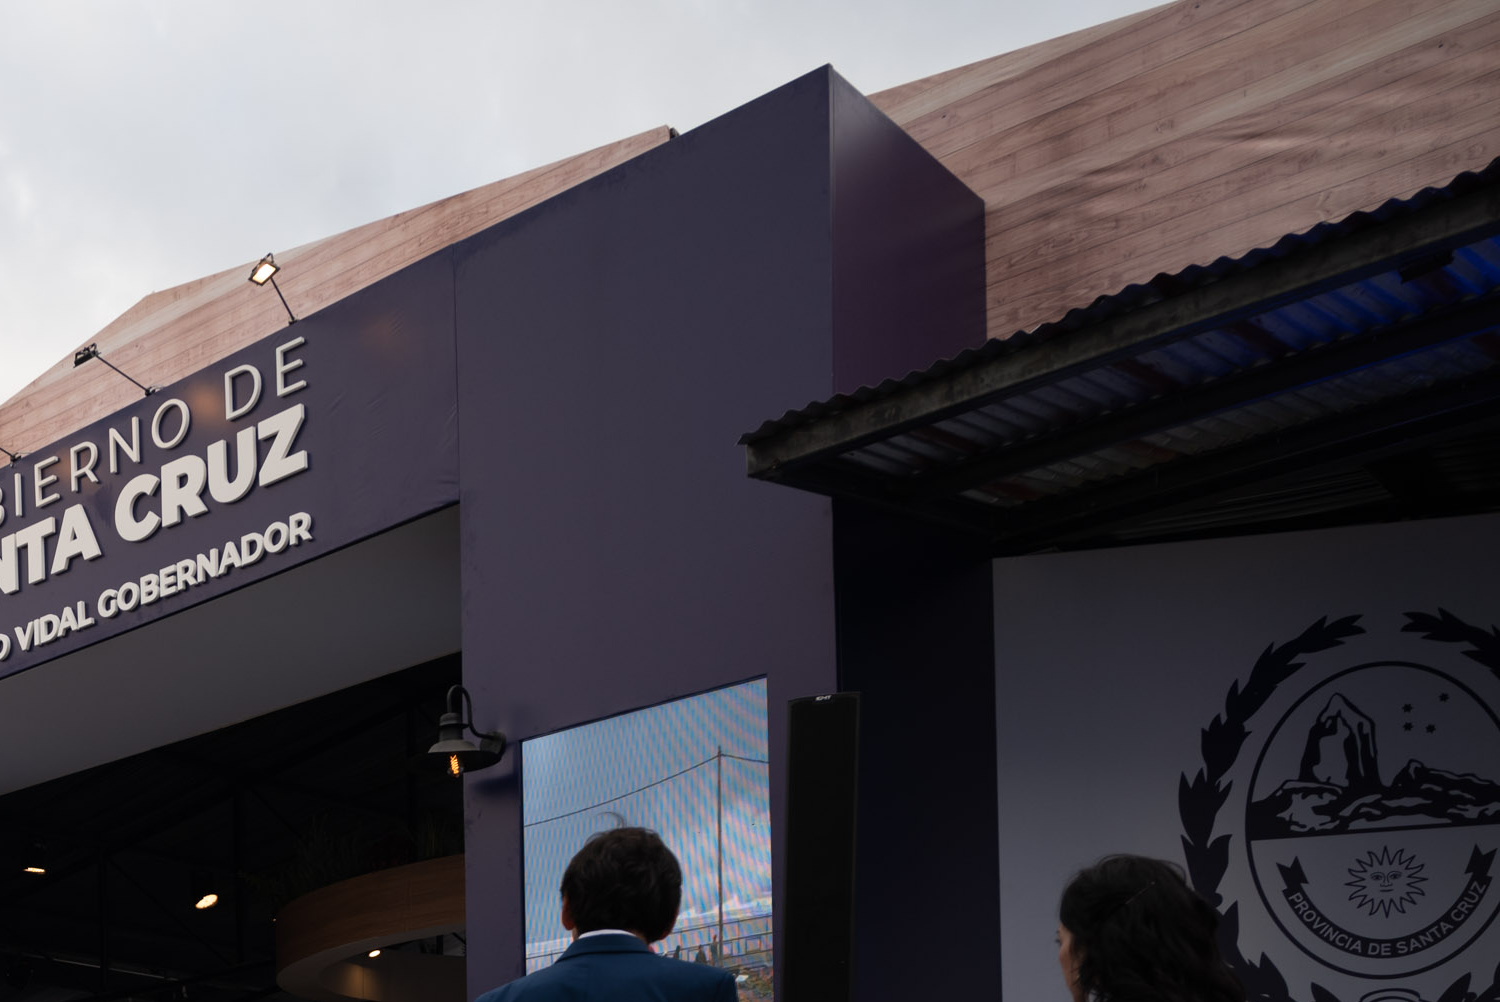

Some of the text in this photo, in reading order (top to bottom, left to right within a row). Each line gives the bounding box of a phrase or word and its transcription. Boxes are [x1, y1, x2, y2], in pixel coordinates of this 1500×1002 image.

[224, 336, 308, 421] DE
[114, 403, 309, 543] CRUZ
[15, 601, 95, 653] VIDAL
[98, 511, 312, 619] GOBERNADOR
[1288, 880, 1487, 956] PROVINCIA DE SANTA CRUZ
